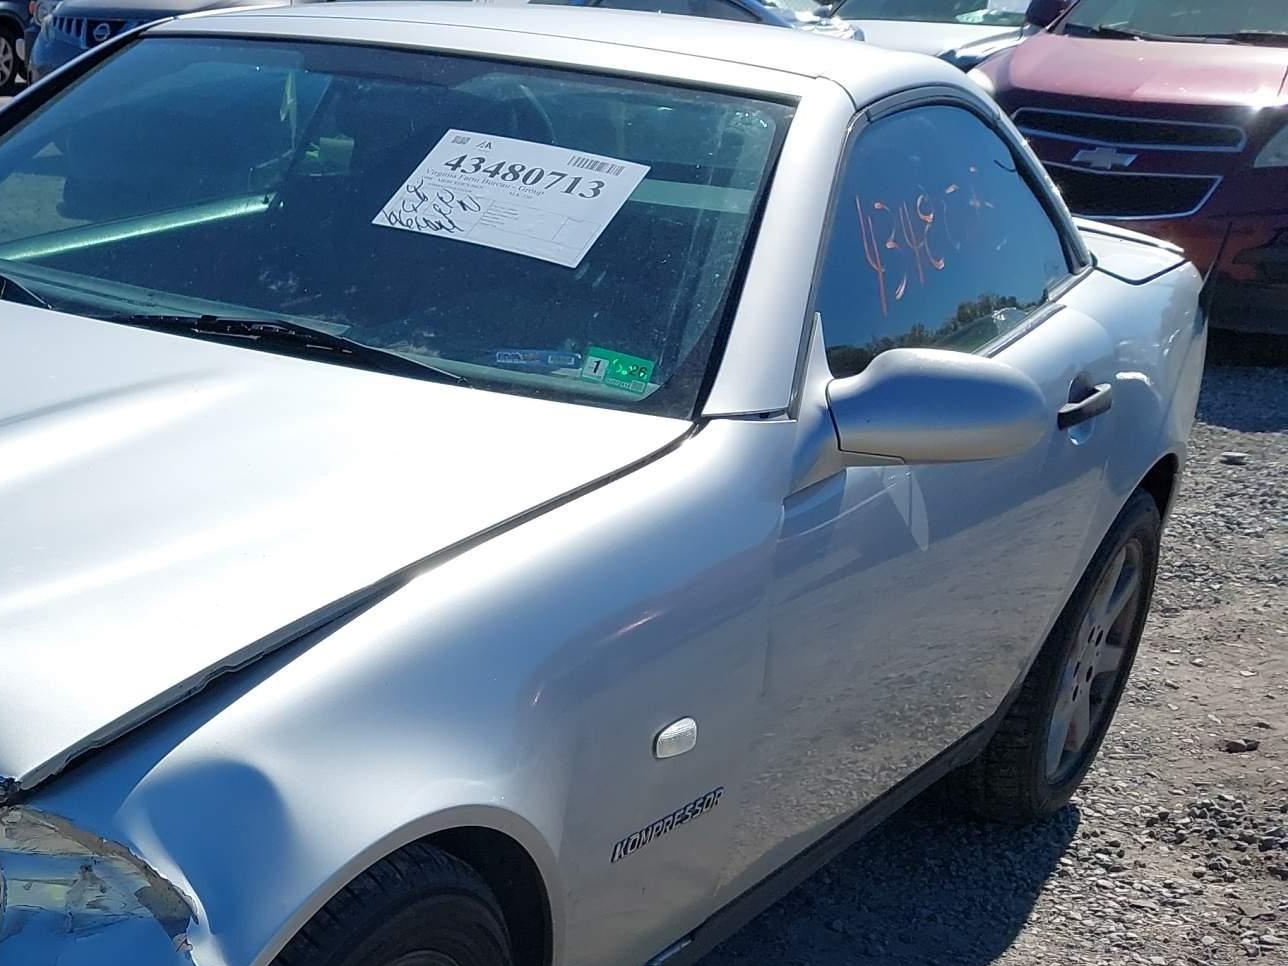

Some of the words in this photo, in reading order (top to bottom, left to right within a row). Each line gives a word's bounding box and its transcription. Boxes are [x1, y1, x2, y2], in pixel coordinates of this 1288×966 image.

[444, 154, 605, 200] 43480713
[591, 359, 602, 374] 1
[628, 364, 648, 378] 26
[611, 786, 724, 863] KOMPRESSOR
